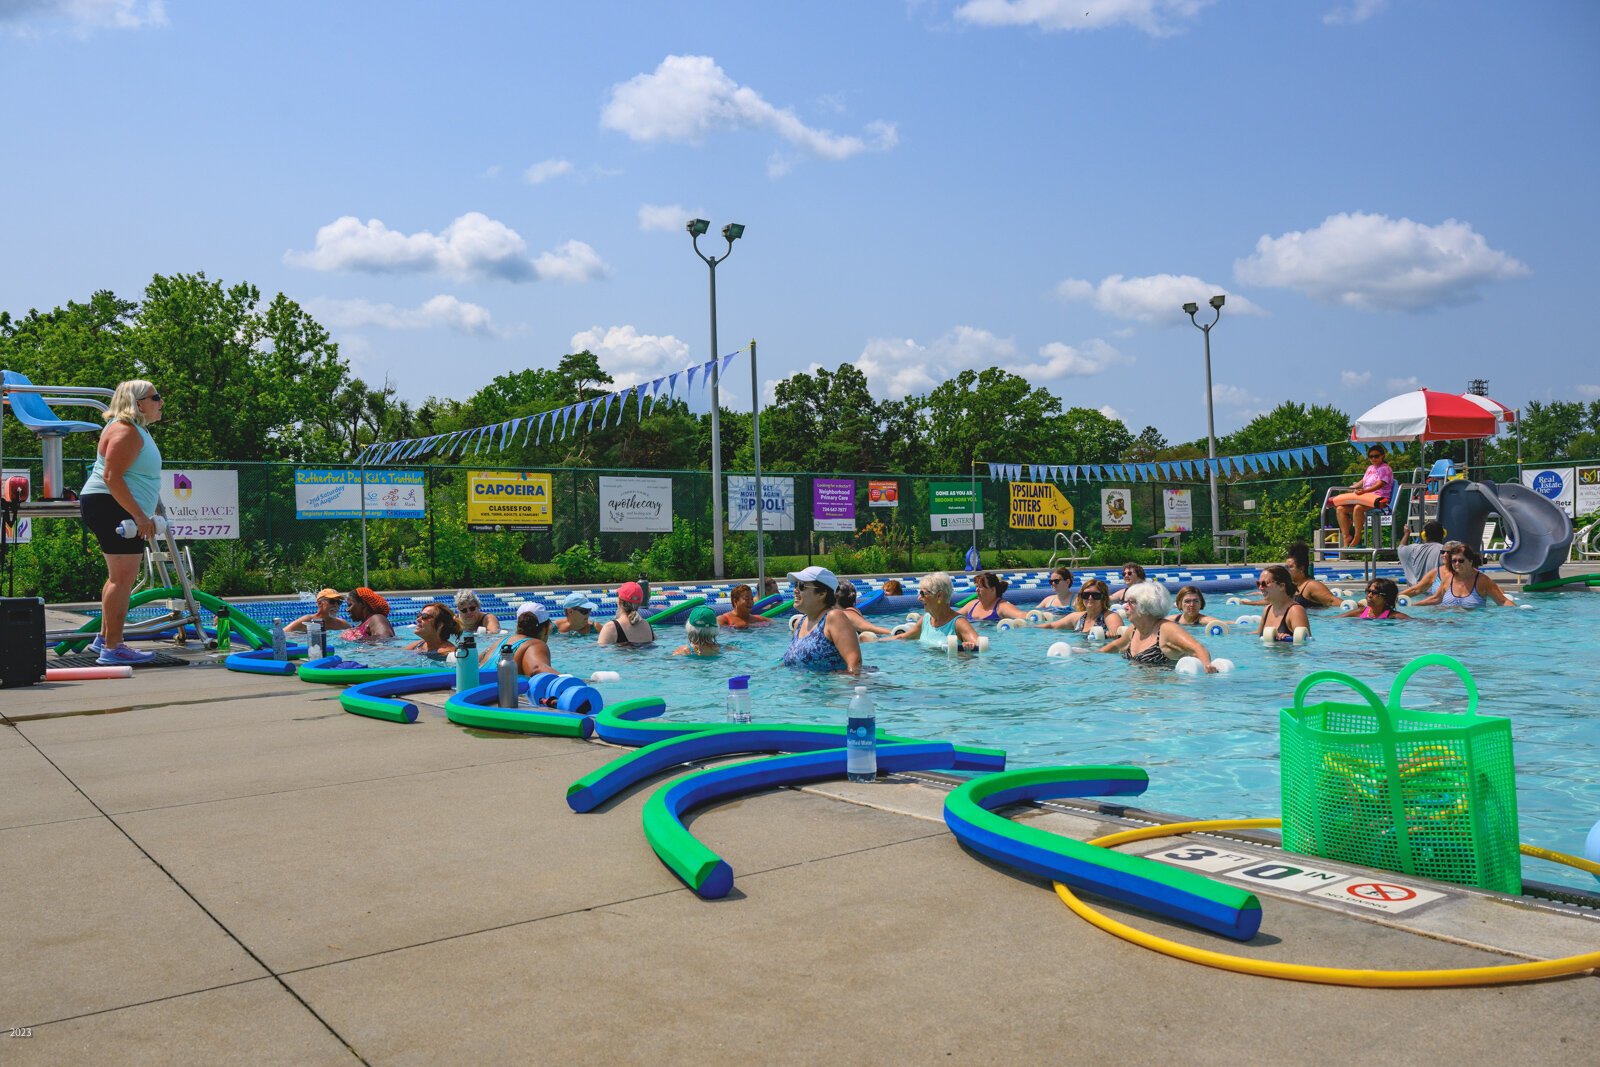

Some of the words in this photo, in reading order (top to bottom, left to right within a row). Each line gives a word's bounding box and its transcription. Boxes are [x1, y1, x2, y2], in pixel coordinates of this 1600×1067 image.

[347, 471, 362, 483] Poo
[388, 473, 423, 484] Triathlon
[1538, 475, 1555, 483] Real
[475, 484, 545, 496] CAPOEIRA
[1012, 485, 1052, 498] YPSILANTI
[608, 494, 663, 516] apothecary
[1013, 499, 1041, 512] OTTERS
[169, 507, 198, 518] Valley
[1012, 514, 1035, 527] SWIM
[1164, 848, 1218, 861] 3
[1219, 854, 1251, 862] FT
[1304, 871, 1336, 880] IN
[1346, 897, 1388, 909] DIVING
